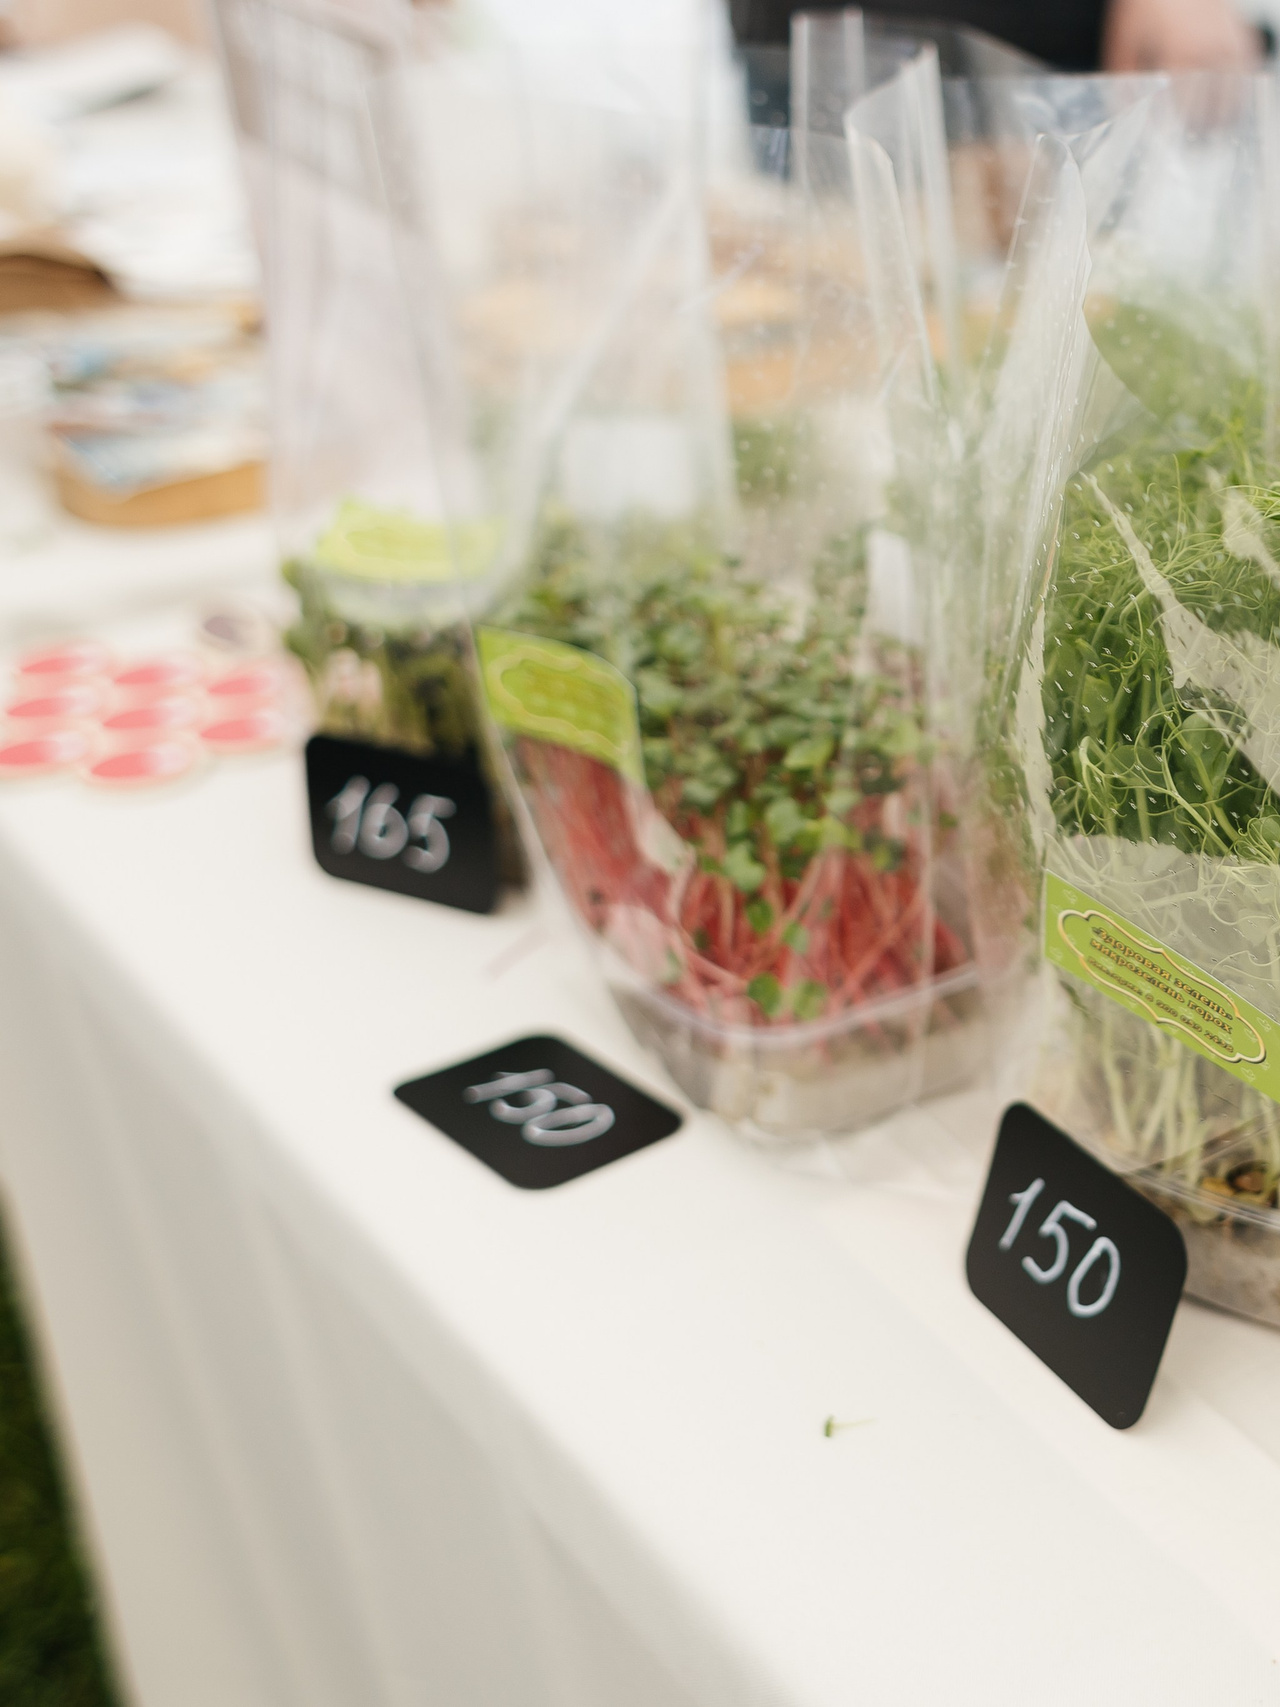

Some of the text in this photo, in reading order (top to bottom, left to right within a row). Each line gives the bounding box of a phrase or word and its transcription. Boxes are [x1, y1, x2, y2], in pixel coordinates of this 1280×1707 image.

[325, 775, 457, 874] 165
[1090, 938, 1233, 1035] микрозелень горох
[462, 1067, 615, 1147] 150
[999, 1177, 1121, 1318] 150
